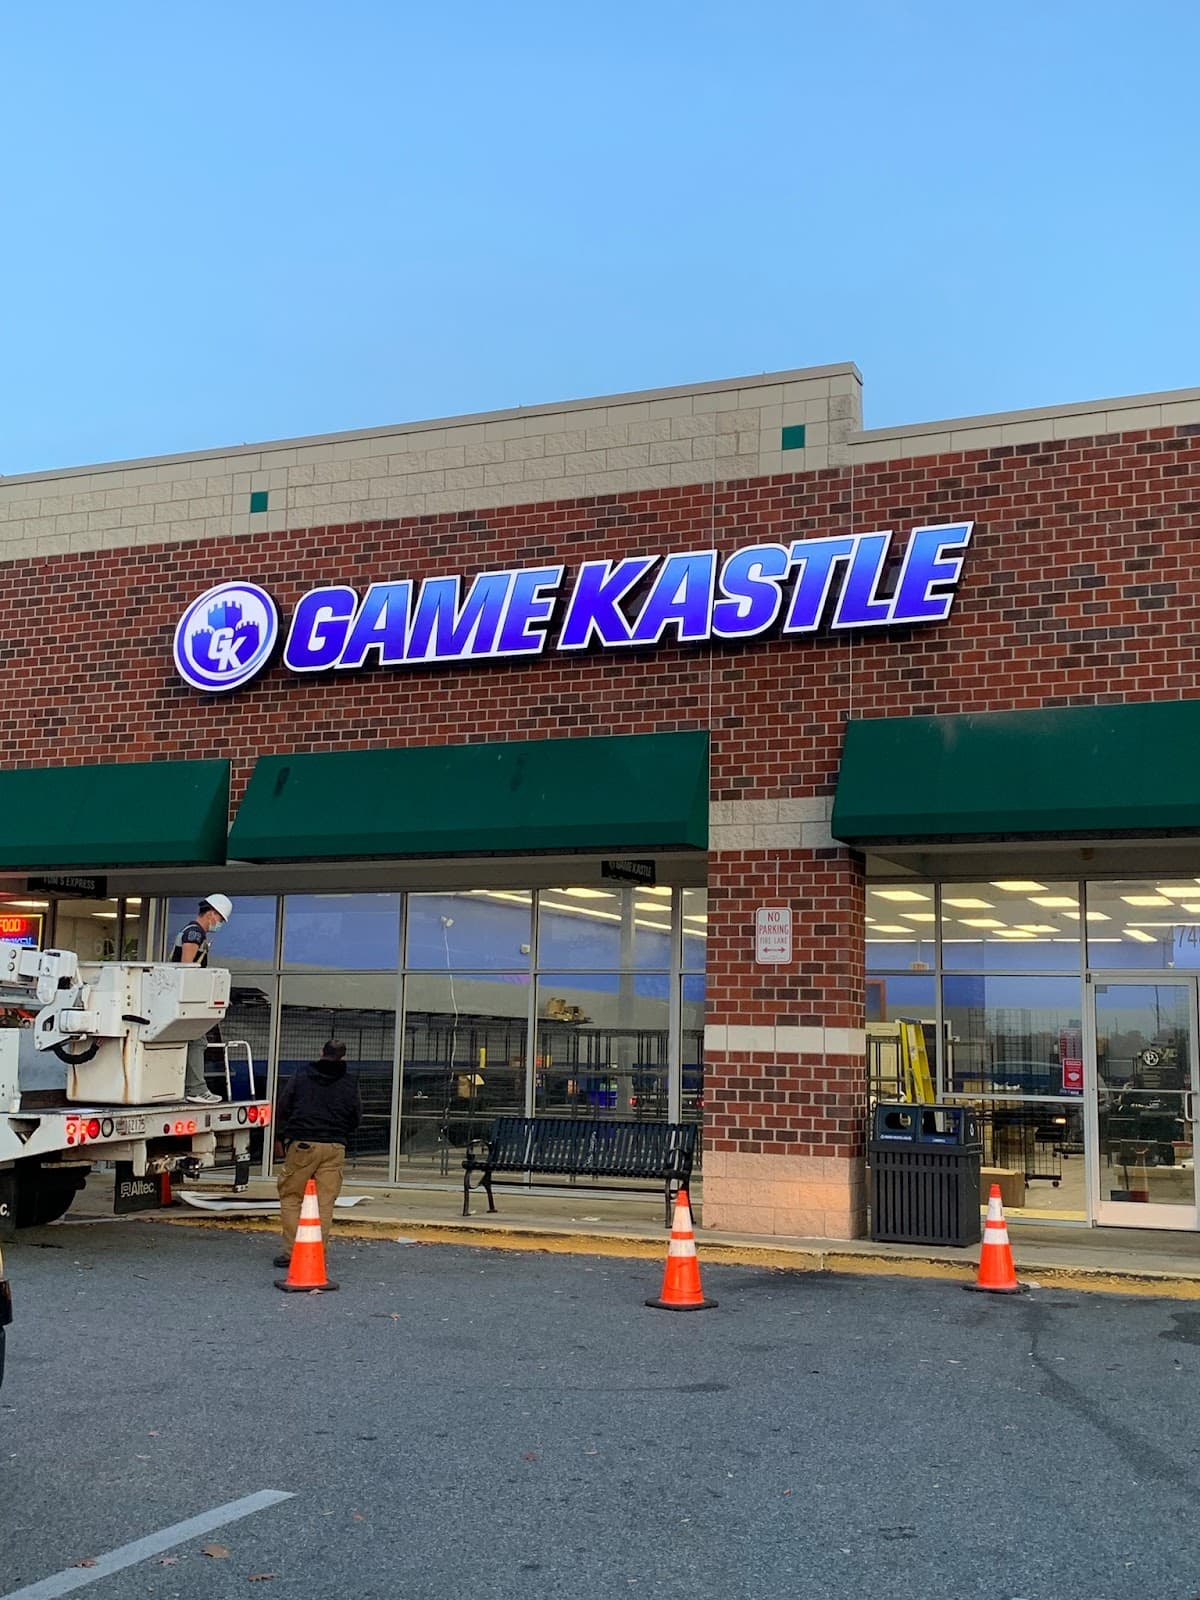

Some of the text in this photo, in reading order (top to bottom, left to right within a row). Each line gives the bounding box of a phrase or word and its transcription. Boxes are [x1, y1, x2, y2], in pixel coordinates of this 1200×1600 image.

[283, 520, 974, 672] GAME KASTLE
[207, 627, 248, 672] GK
[65, 877, 97, 890] EXPRESS
[767, 911, 781, 922] NO
[758, 924, 789, 935] PARKING
[130, 1181, 154, 1196] Altec
